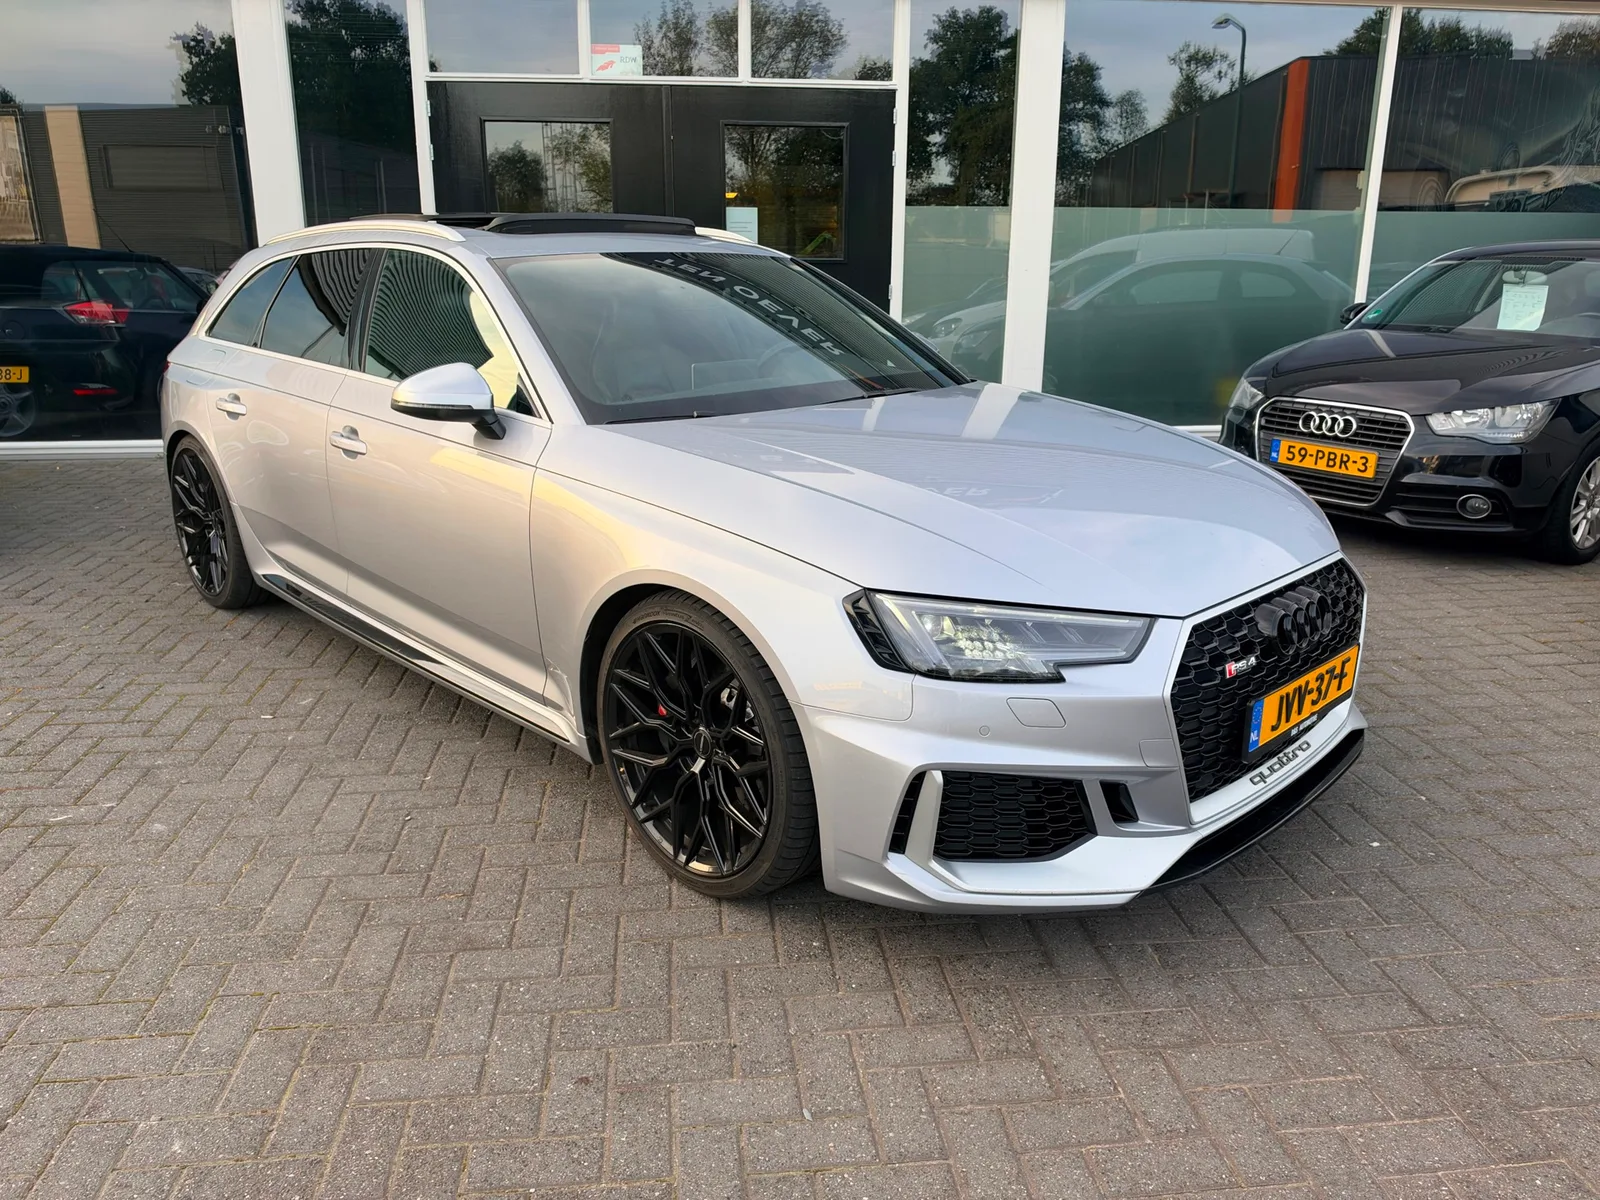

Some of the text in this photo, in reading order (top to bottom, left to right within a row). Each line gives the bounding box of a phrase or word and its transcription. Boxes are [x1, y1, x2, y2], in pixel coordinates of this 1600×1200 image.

[1286, 445, 1369, 473] 59-PBR-3
[1250, 730, 1258, 743] NL
[1249, 740, 1312, 786] quattro
